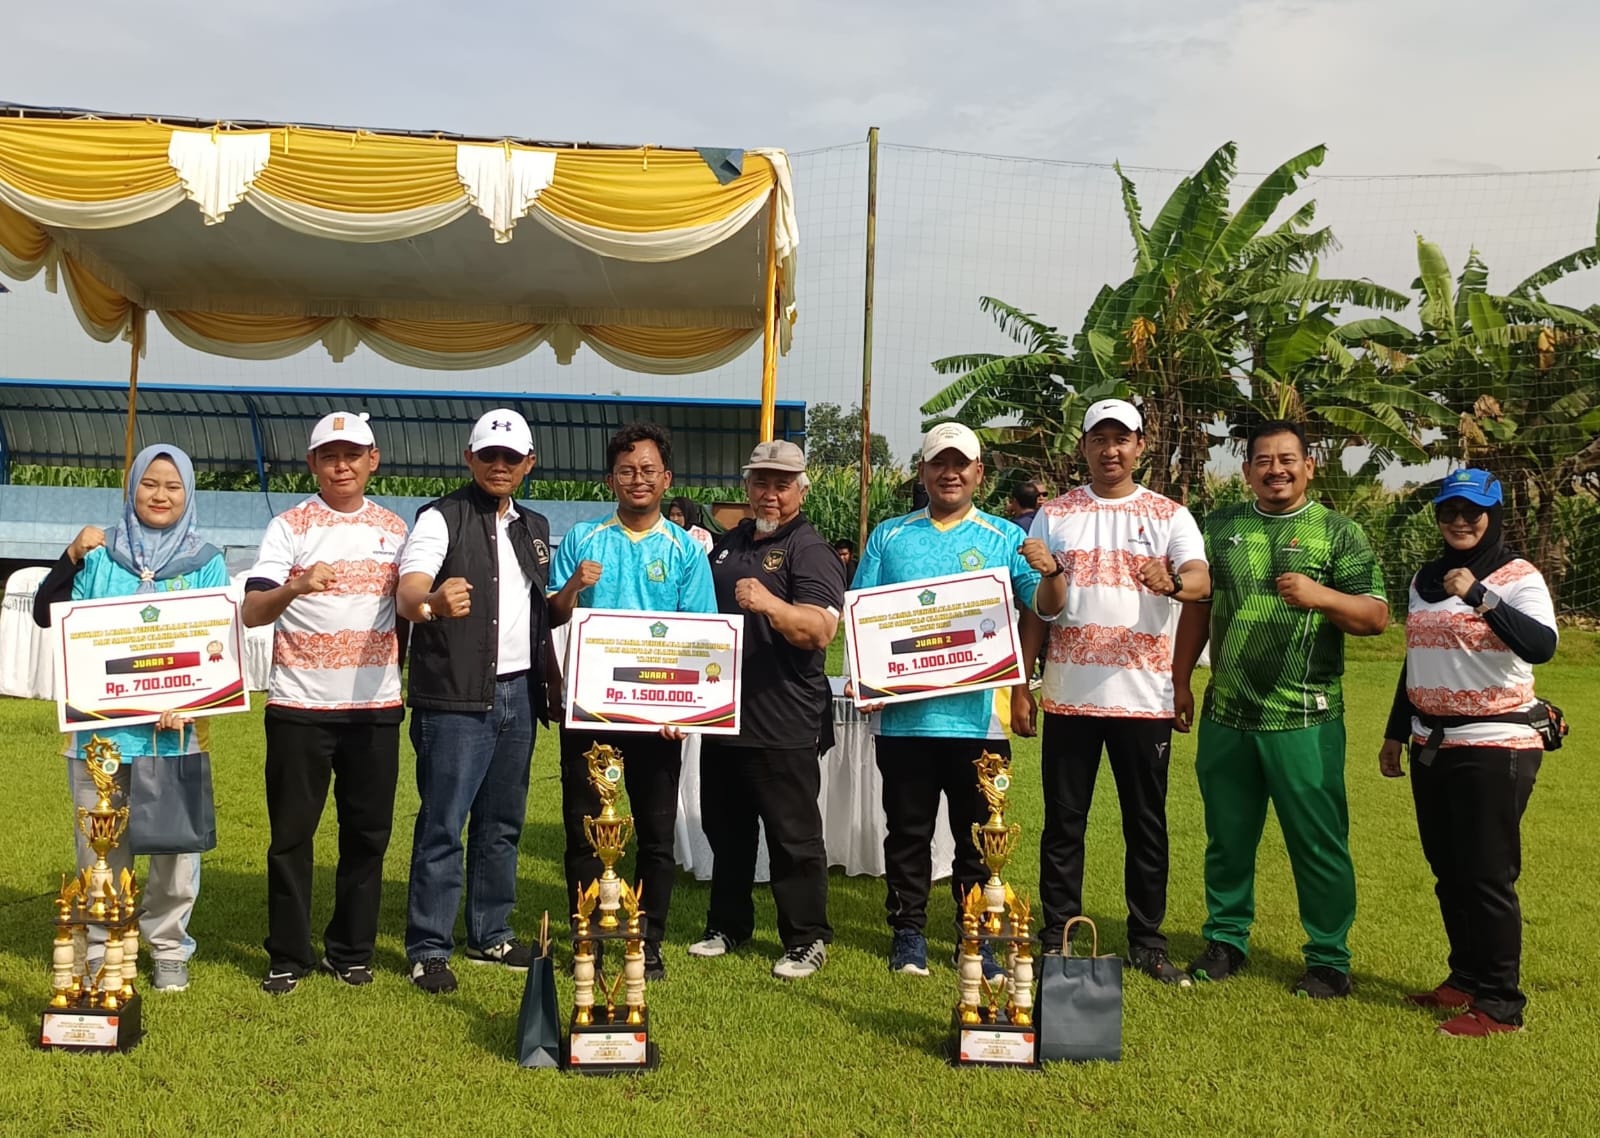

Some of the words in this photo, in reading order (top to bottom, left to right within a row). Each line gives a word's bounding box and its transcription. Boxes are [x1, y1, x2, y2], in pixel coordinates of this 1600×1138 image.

[914, 637, 943, 648] JUARA
[945, 635, 952, 644] 2
[132, 657, 164, 669] JUARA
[167, 656, 174, 665] 3
[888, 661, 909, 675] Rp.
[911, 650, 984, 669] 1.000.000,-
[638, 671, 668, 680] JUARA
[670, 671, 675, 680] 1
[105, 682, 129, 696] Rp.
[133, 674, 203, 691] 700.000,-
[606, 687, 627, 702] Rp.
[631, 688, 703, 704] 1.500.000,-
